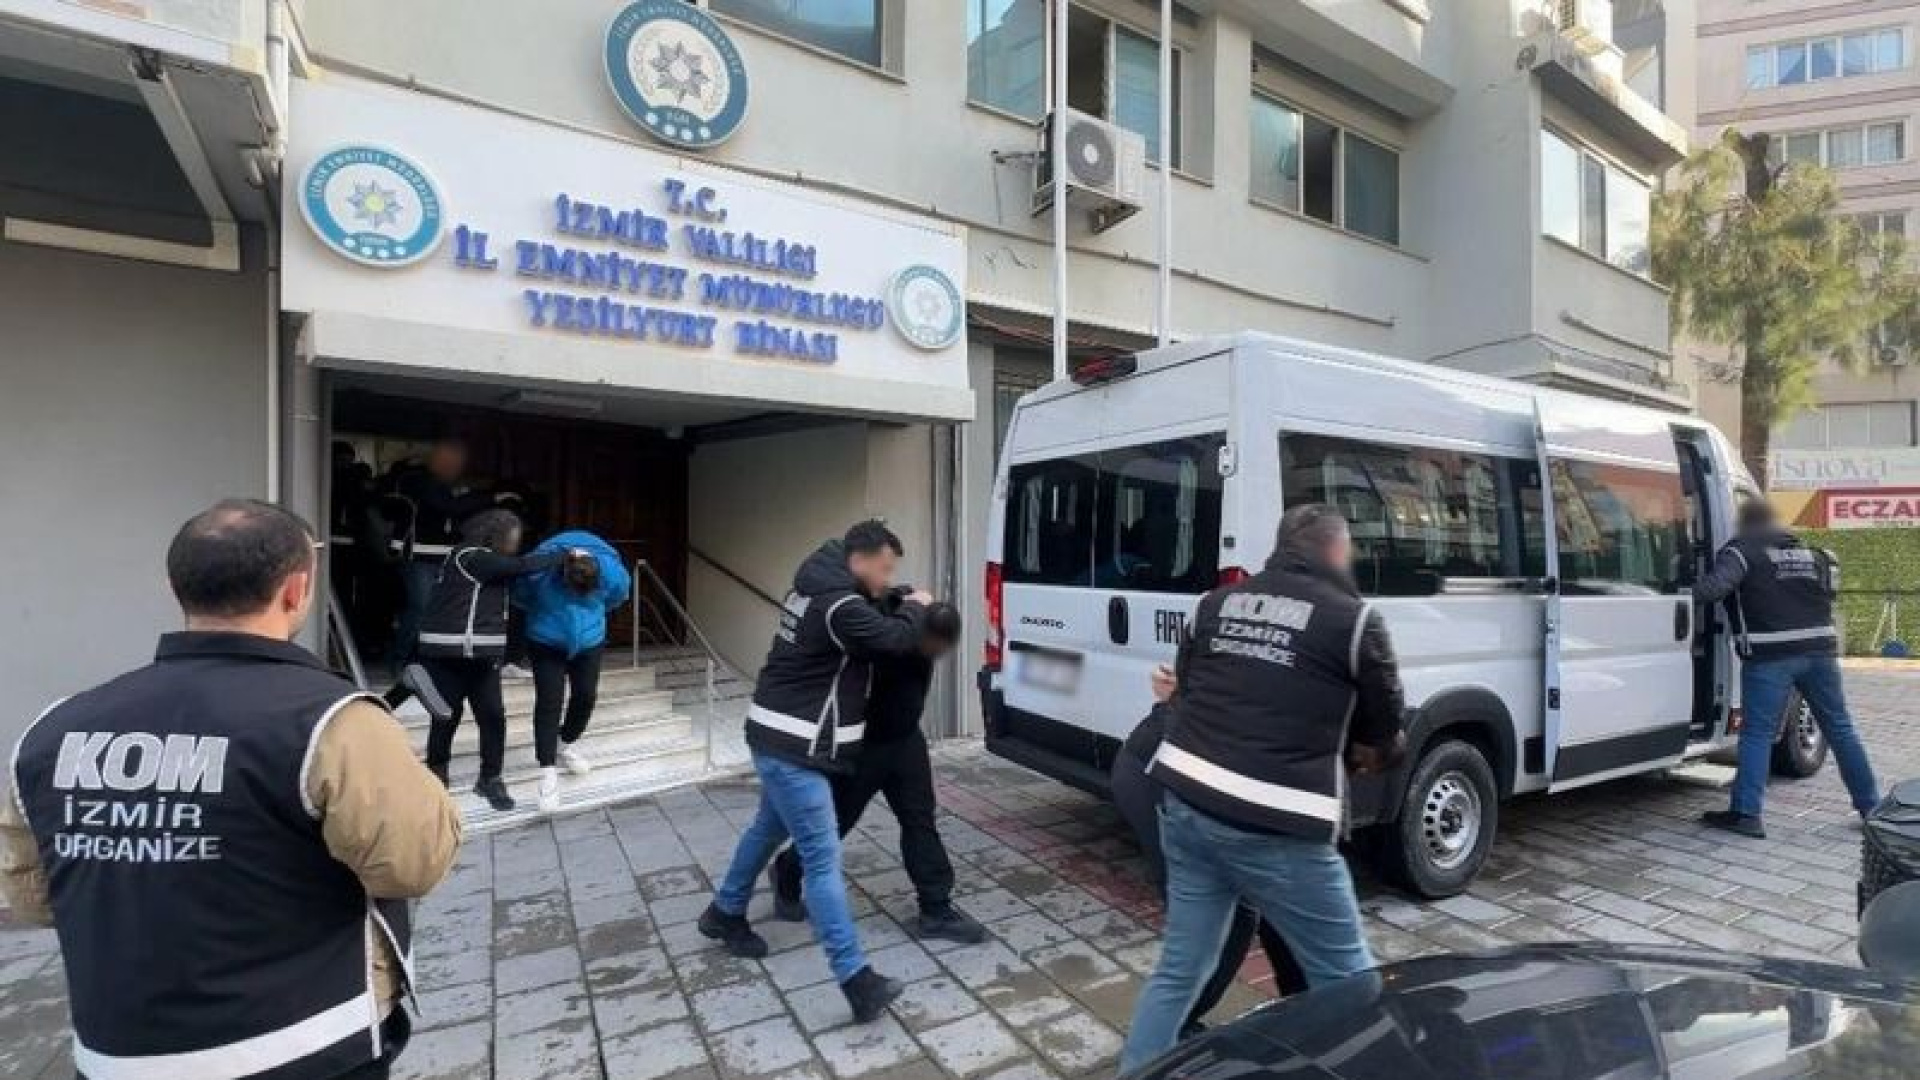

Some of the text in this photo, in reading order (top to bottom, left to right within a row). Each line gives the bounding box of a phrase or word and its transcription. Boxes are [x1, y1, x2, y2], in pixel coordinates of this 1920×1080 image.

[556, 193, 669, 251] İZMİR
[455, 223, 498, 270] İL
[515, 239, 688, 301] EMNİYET
[1154, 609, 1187, 644] FIAT
[53, 731, 229, 792] KOM
[64, 795, 202, 828] İZMİR
[54, 832, 223, 862] ORGANİZE
